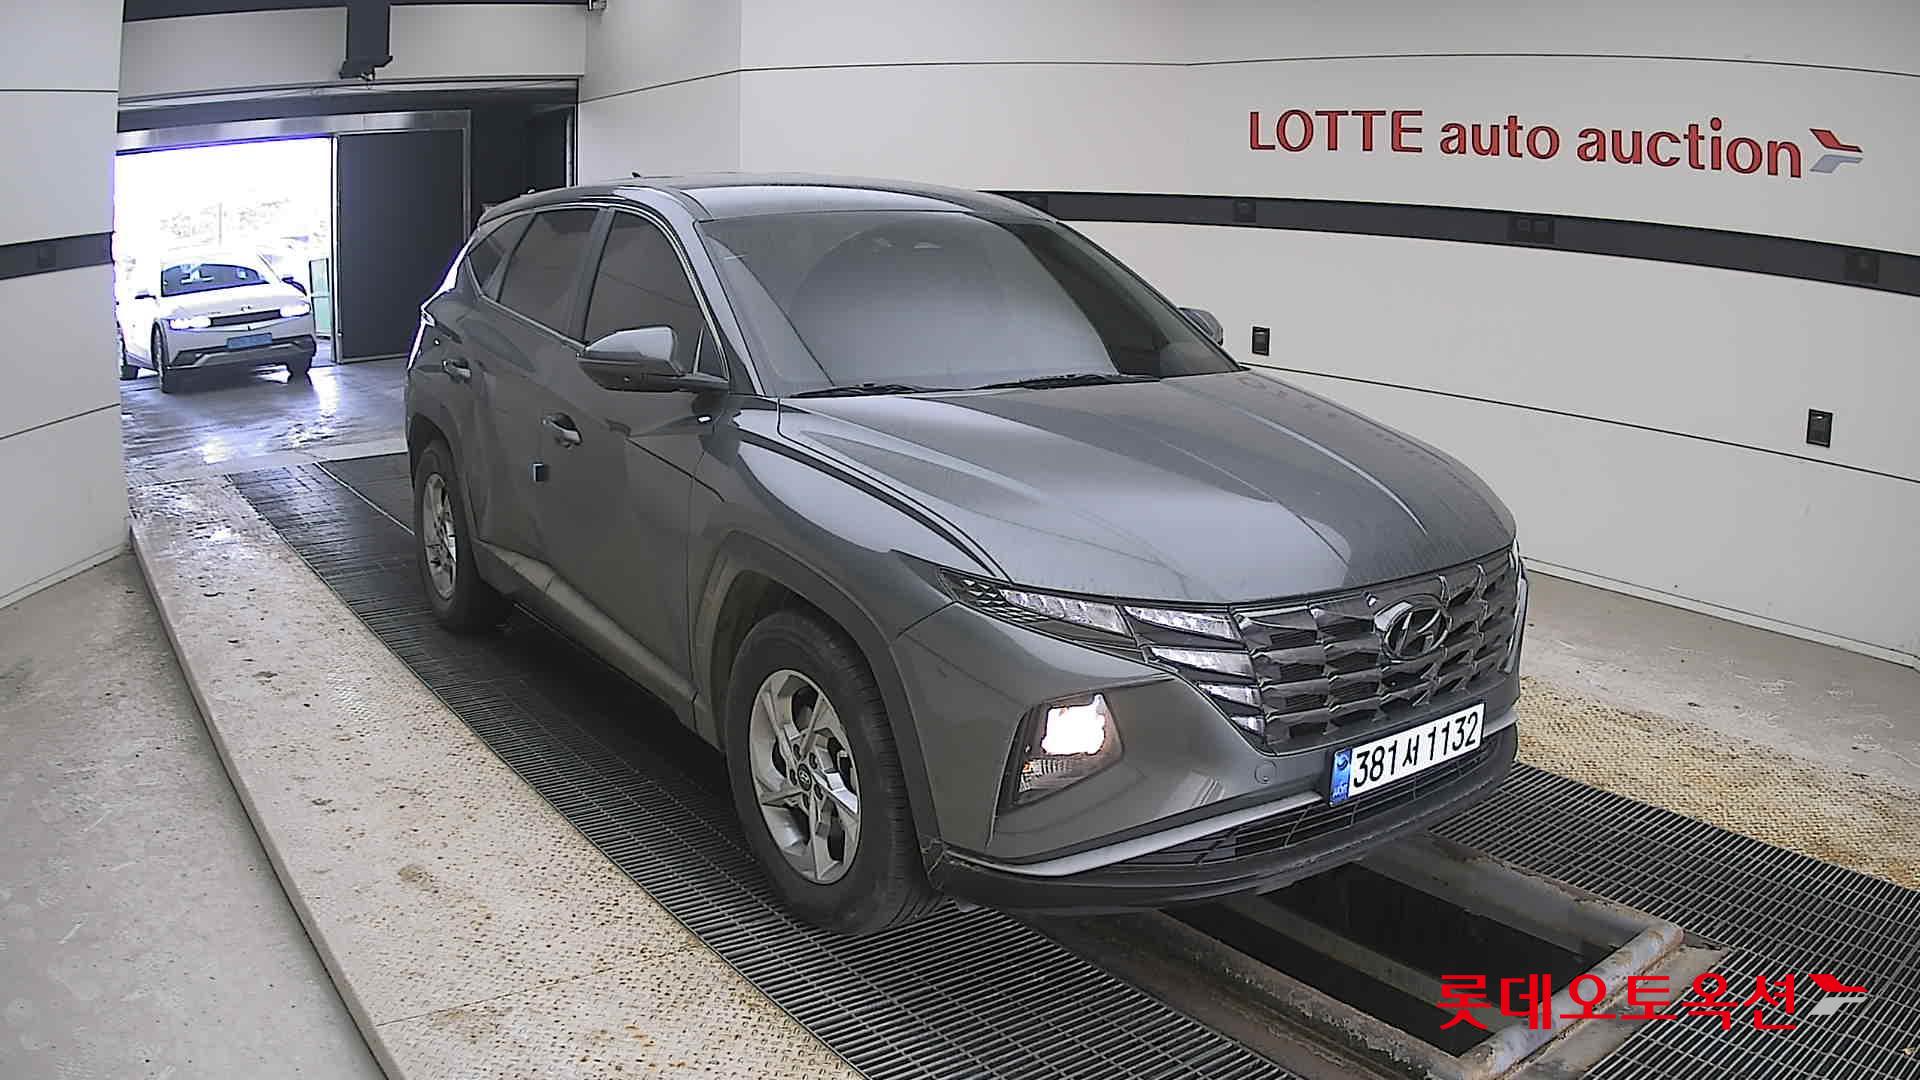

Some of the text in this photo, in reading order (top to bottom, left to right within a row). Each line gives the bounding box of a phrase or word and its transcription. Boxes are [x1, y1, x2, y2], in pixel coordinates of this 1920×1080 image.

[1249, 110, 1802, 178] LOTTE auto auction
[1427, 711, 1478, 761] 1132
